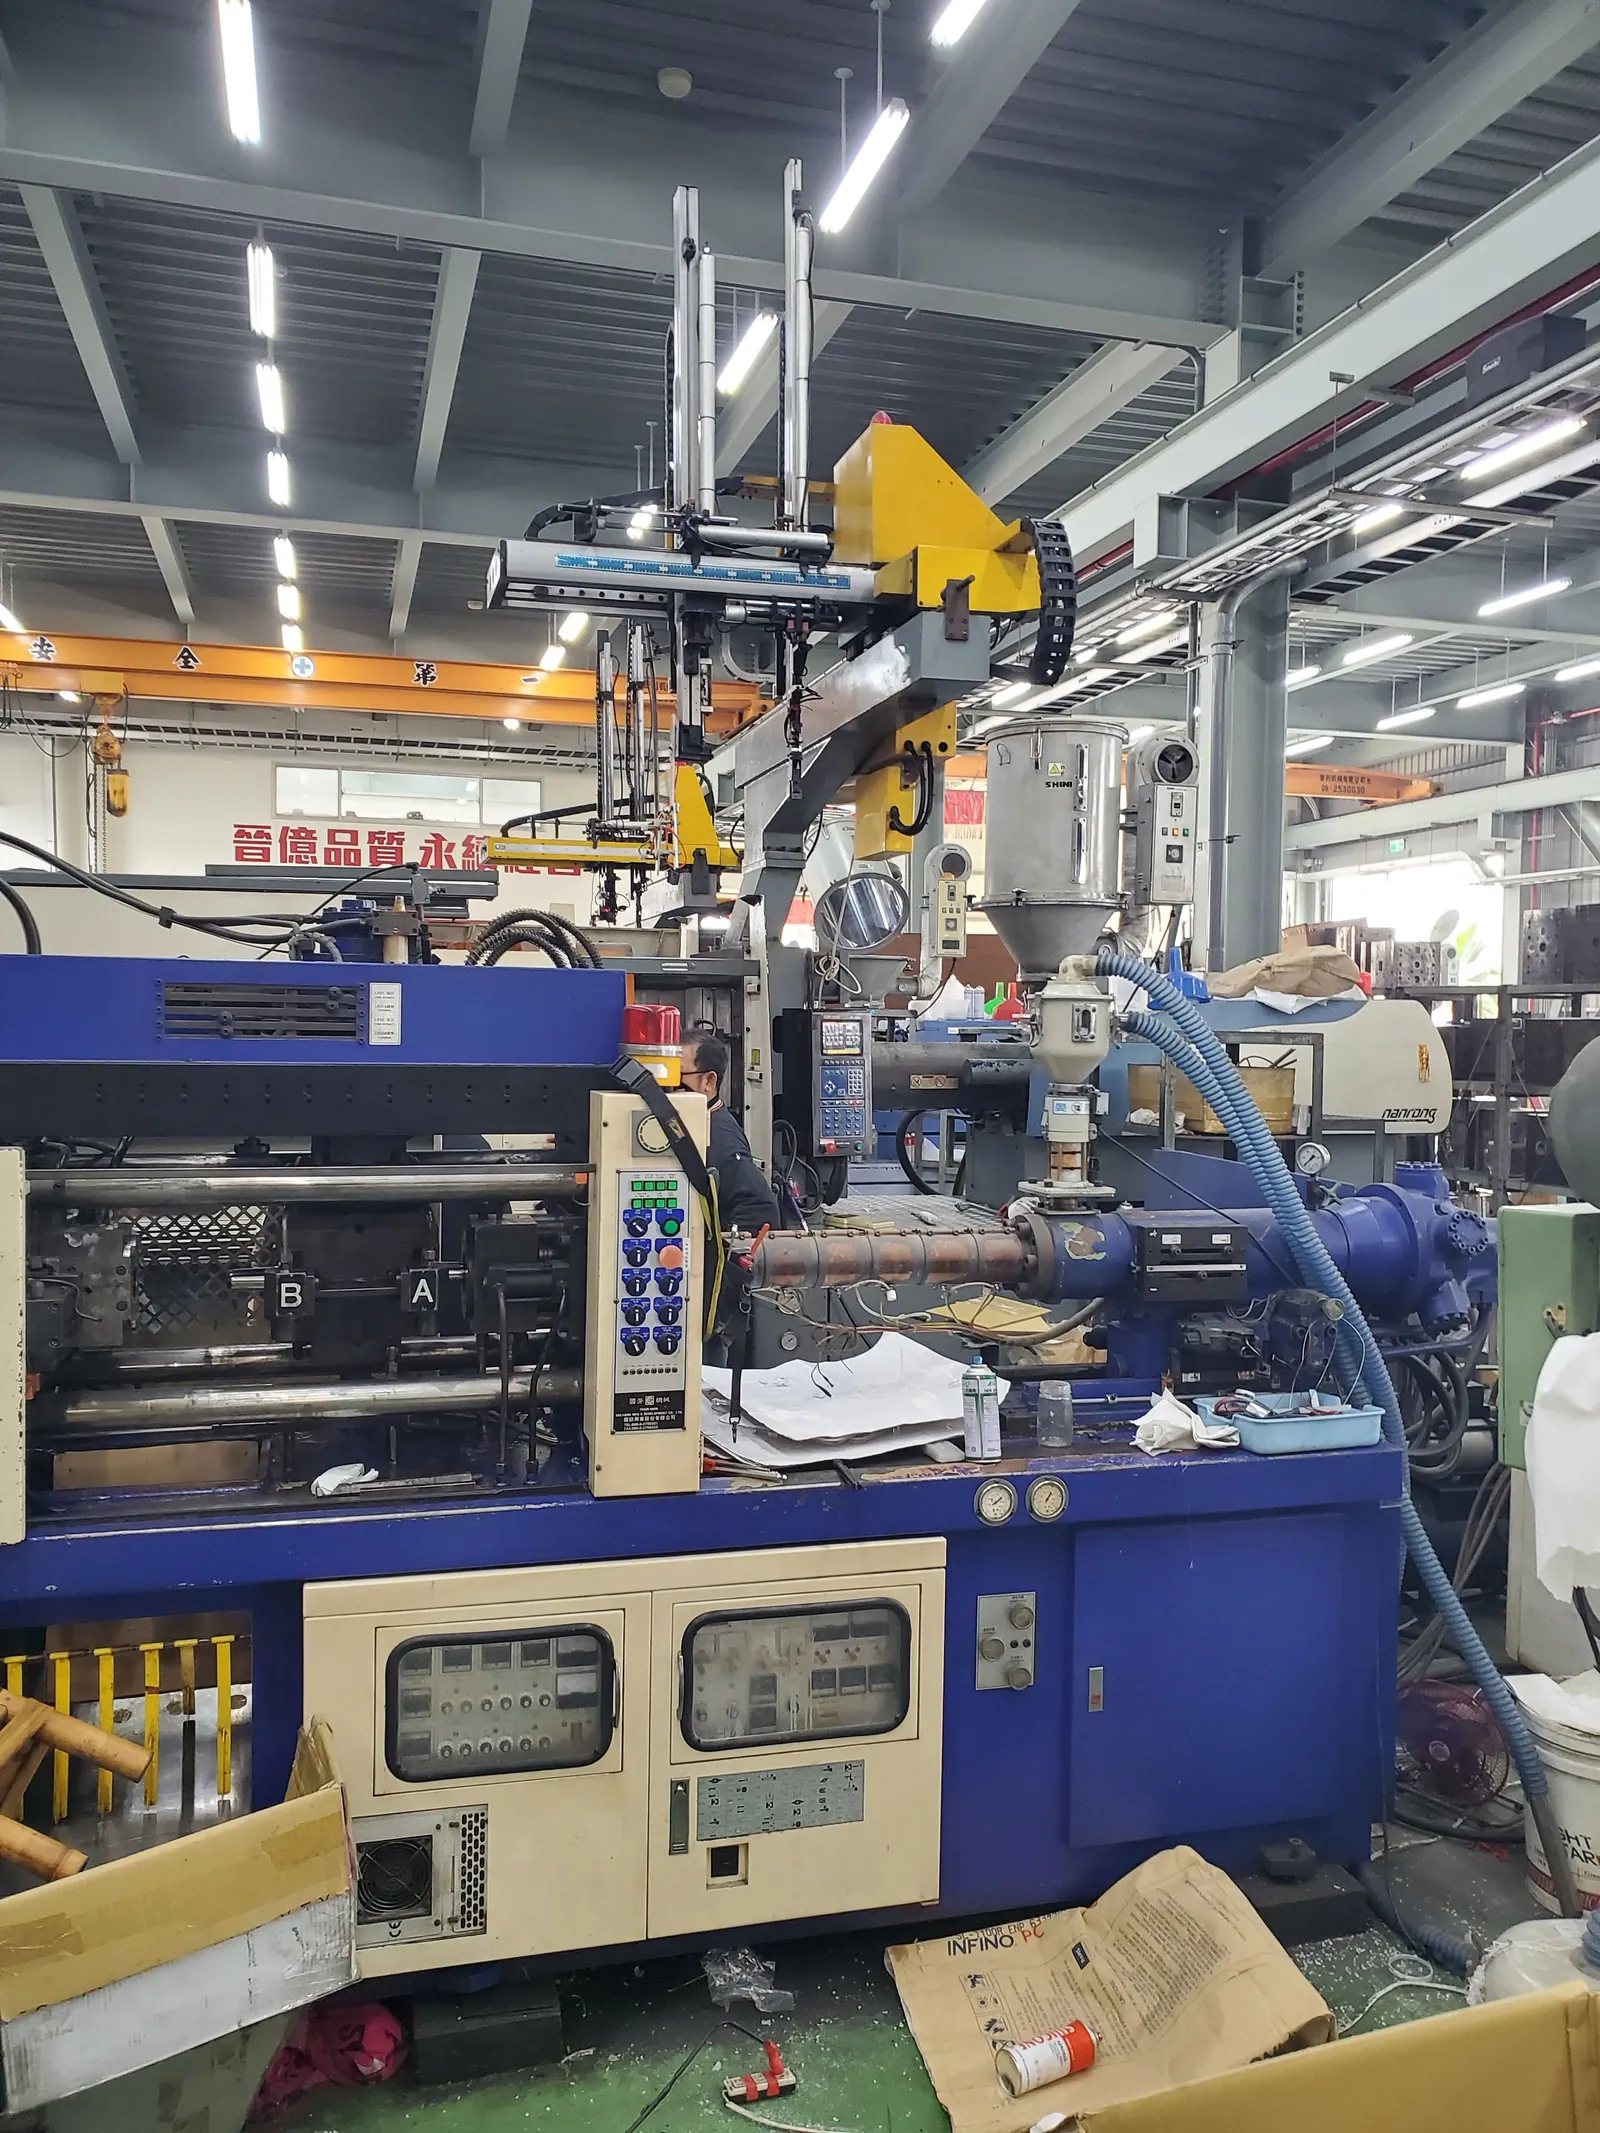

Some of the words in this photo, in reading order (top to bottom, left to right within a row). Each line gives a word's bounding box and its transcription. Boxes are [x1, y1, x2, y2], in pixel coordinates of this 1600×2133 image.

[1382, 1108, 1438, 1124] nanrong
[280, 1283, 302, 1308] B
[412, 1278, 434, 1303] A
[948, 1934, 1014, 1956] INFINO
[1021, 1921, 1045, 1943] PC
